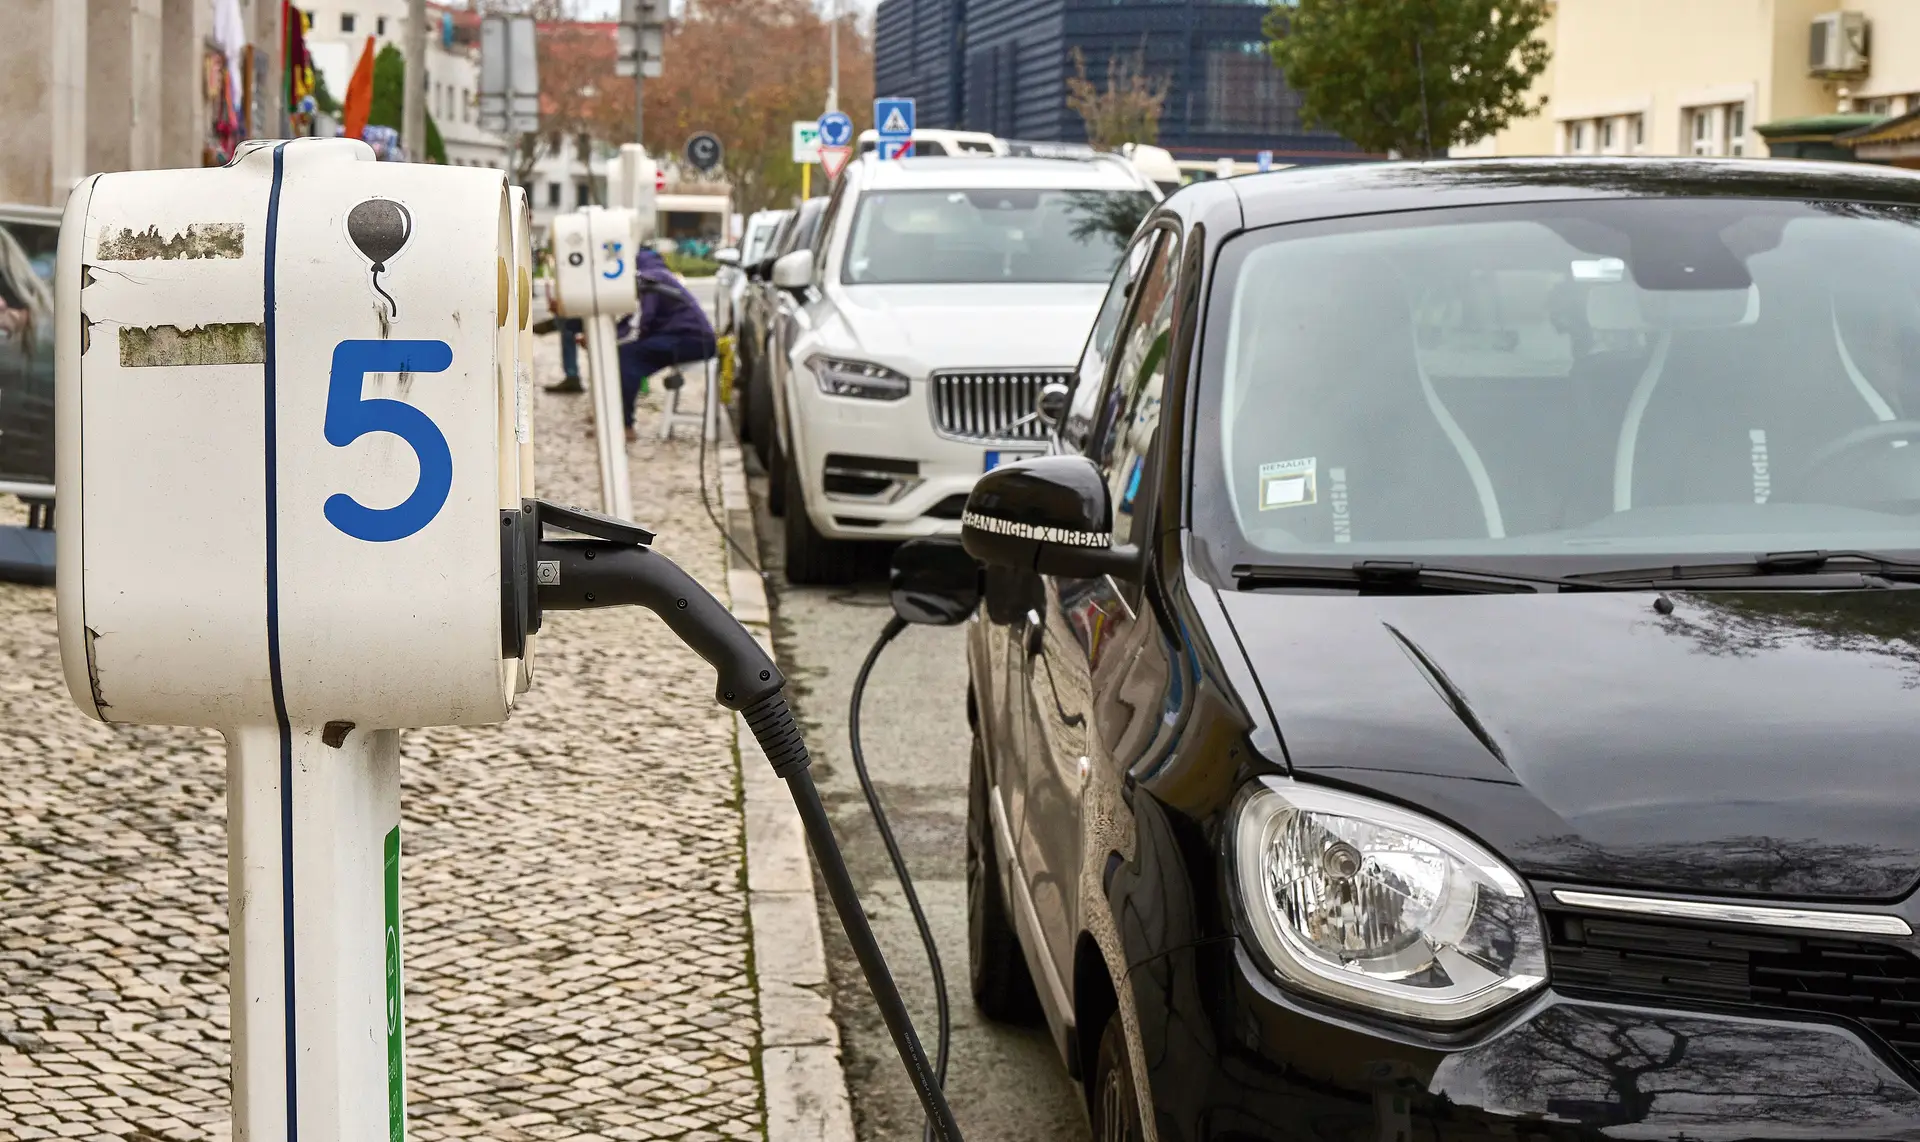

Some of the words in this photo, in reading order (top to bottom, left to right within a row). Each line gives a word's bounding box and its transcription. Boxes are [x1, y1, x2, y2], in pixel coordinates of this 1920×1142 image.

[324, 339, 453, 541] 5
[1262, 459, 1312, 471] RENAULT
[996, 519, 1034, 540] NIGHT
[1042, 526, 1051, 541] X
[1056, 528, 1111, 547] URBAN
[543, 568, 550, 577] C
